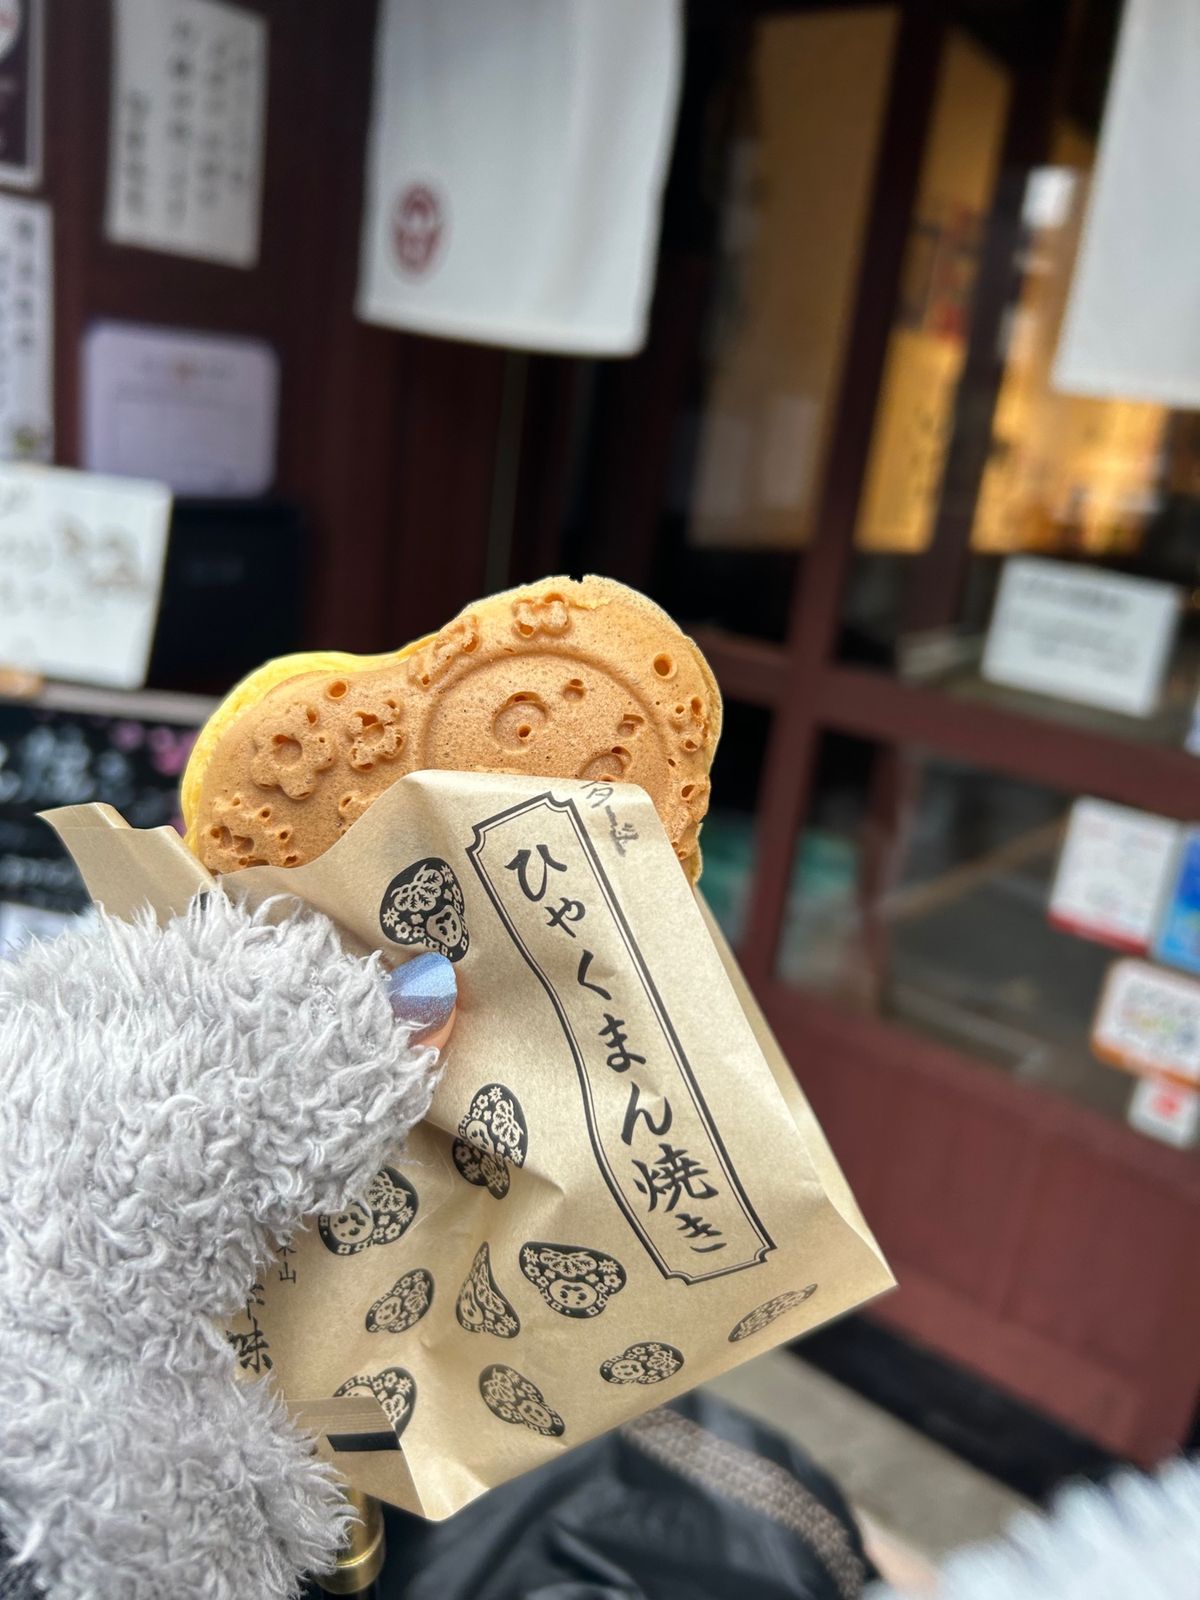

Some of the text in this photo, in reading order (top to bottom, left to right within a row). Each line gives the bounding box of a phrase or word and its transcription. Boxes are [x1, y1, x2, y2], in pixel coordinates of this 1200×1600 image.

[504, 844, 728, 1255] ひゃくまん焼き
